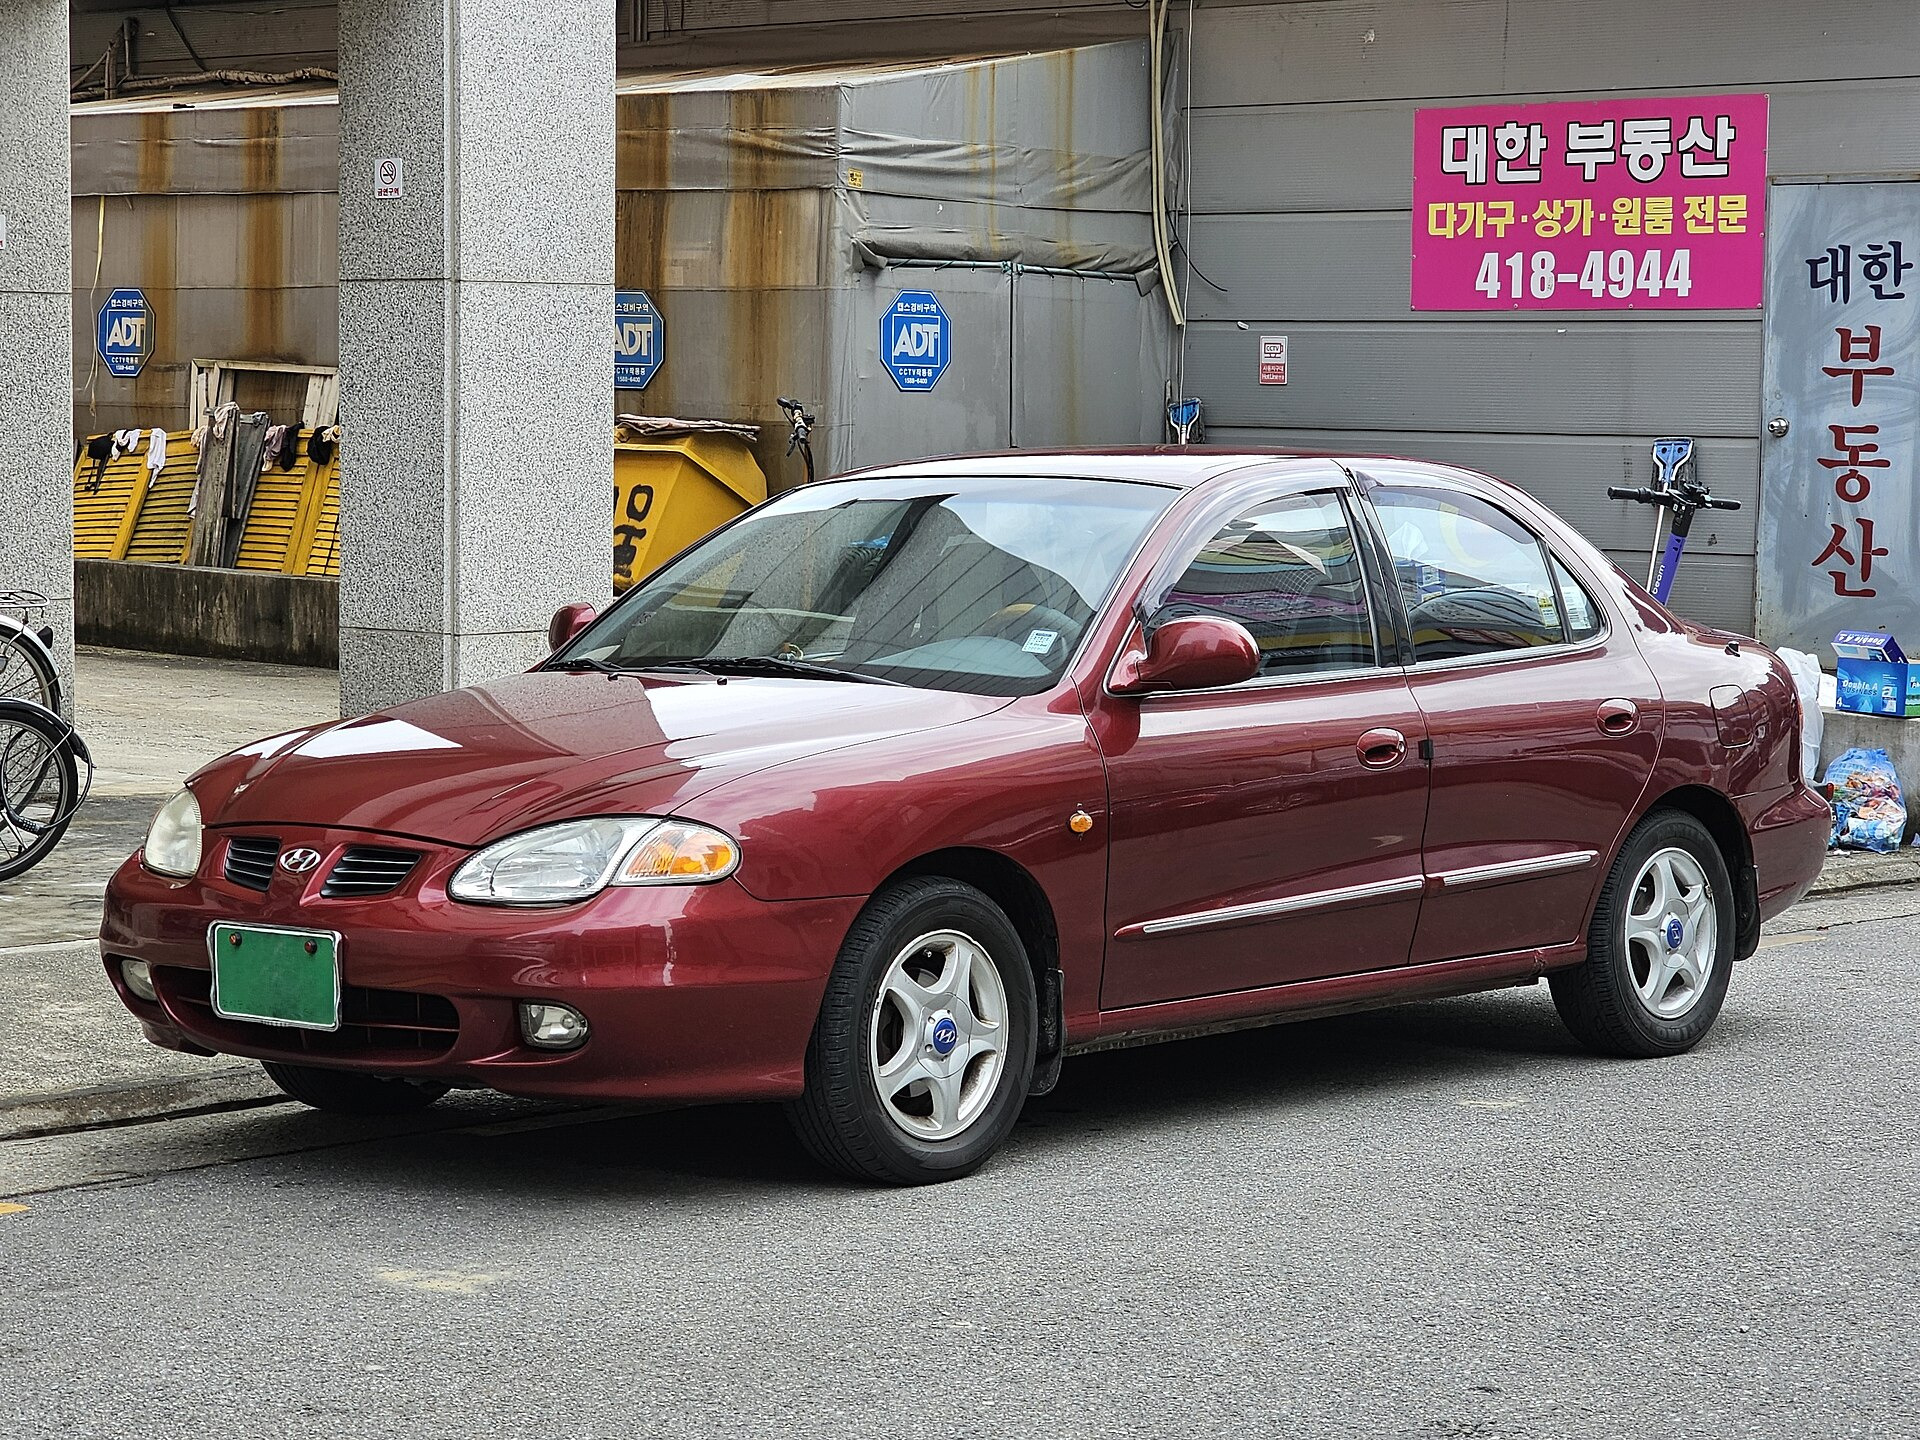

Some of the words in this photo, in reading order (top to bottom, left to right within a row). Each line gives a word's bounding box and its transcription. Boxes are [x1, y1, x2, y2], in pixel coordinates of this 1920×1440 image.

[1441, 121, 1547, 186] 대한
[1564, 115, 1737, 183] 부동산
[1683, 194, 1749, 236] 전문
[1475, 249, 1693, 300] 418-4944
[1805, 240, 1914, 304] 대한
[615, 303, 649, 312] 스경비구역
[107, 317, 146, 347] ADT
[893, 322, 939, 357] ADT
[614, 367, 646, 376] CTV작동중
[1811, 324, 1896, 598] 부동산
[1652, 564, 1666, 595] beam
[1841, 679, 1871, 690] Double
[1842, 686, 1878, 696] BUSINESS
